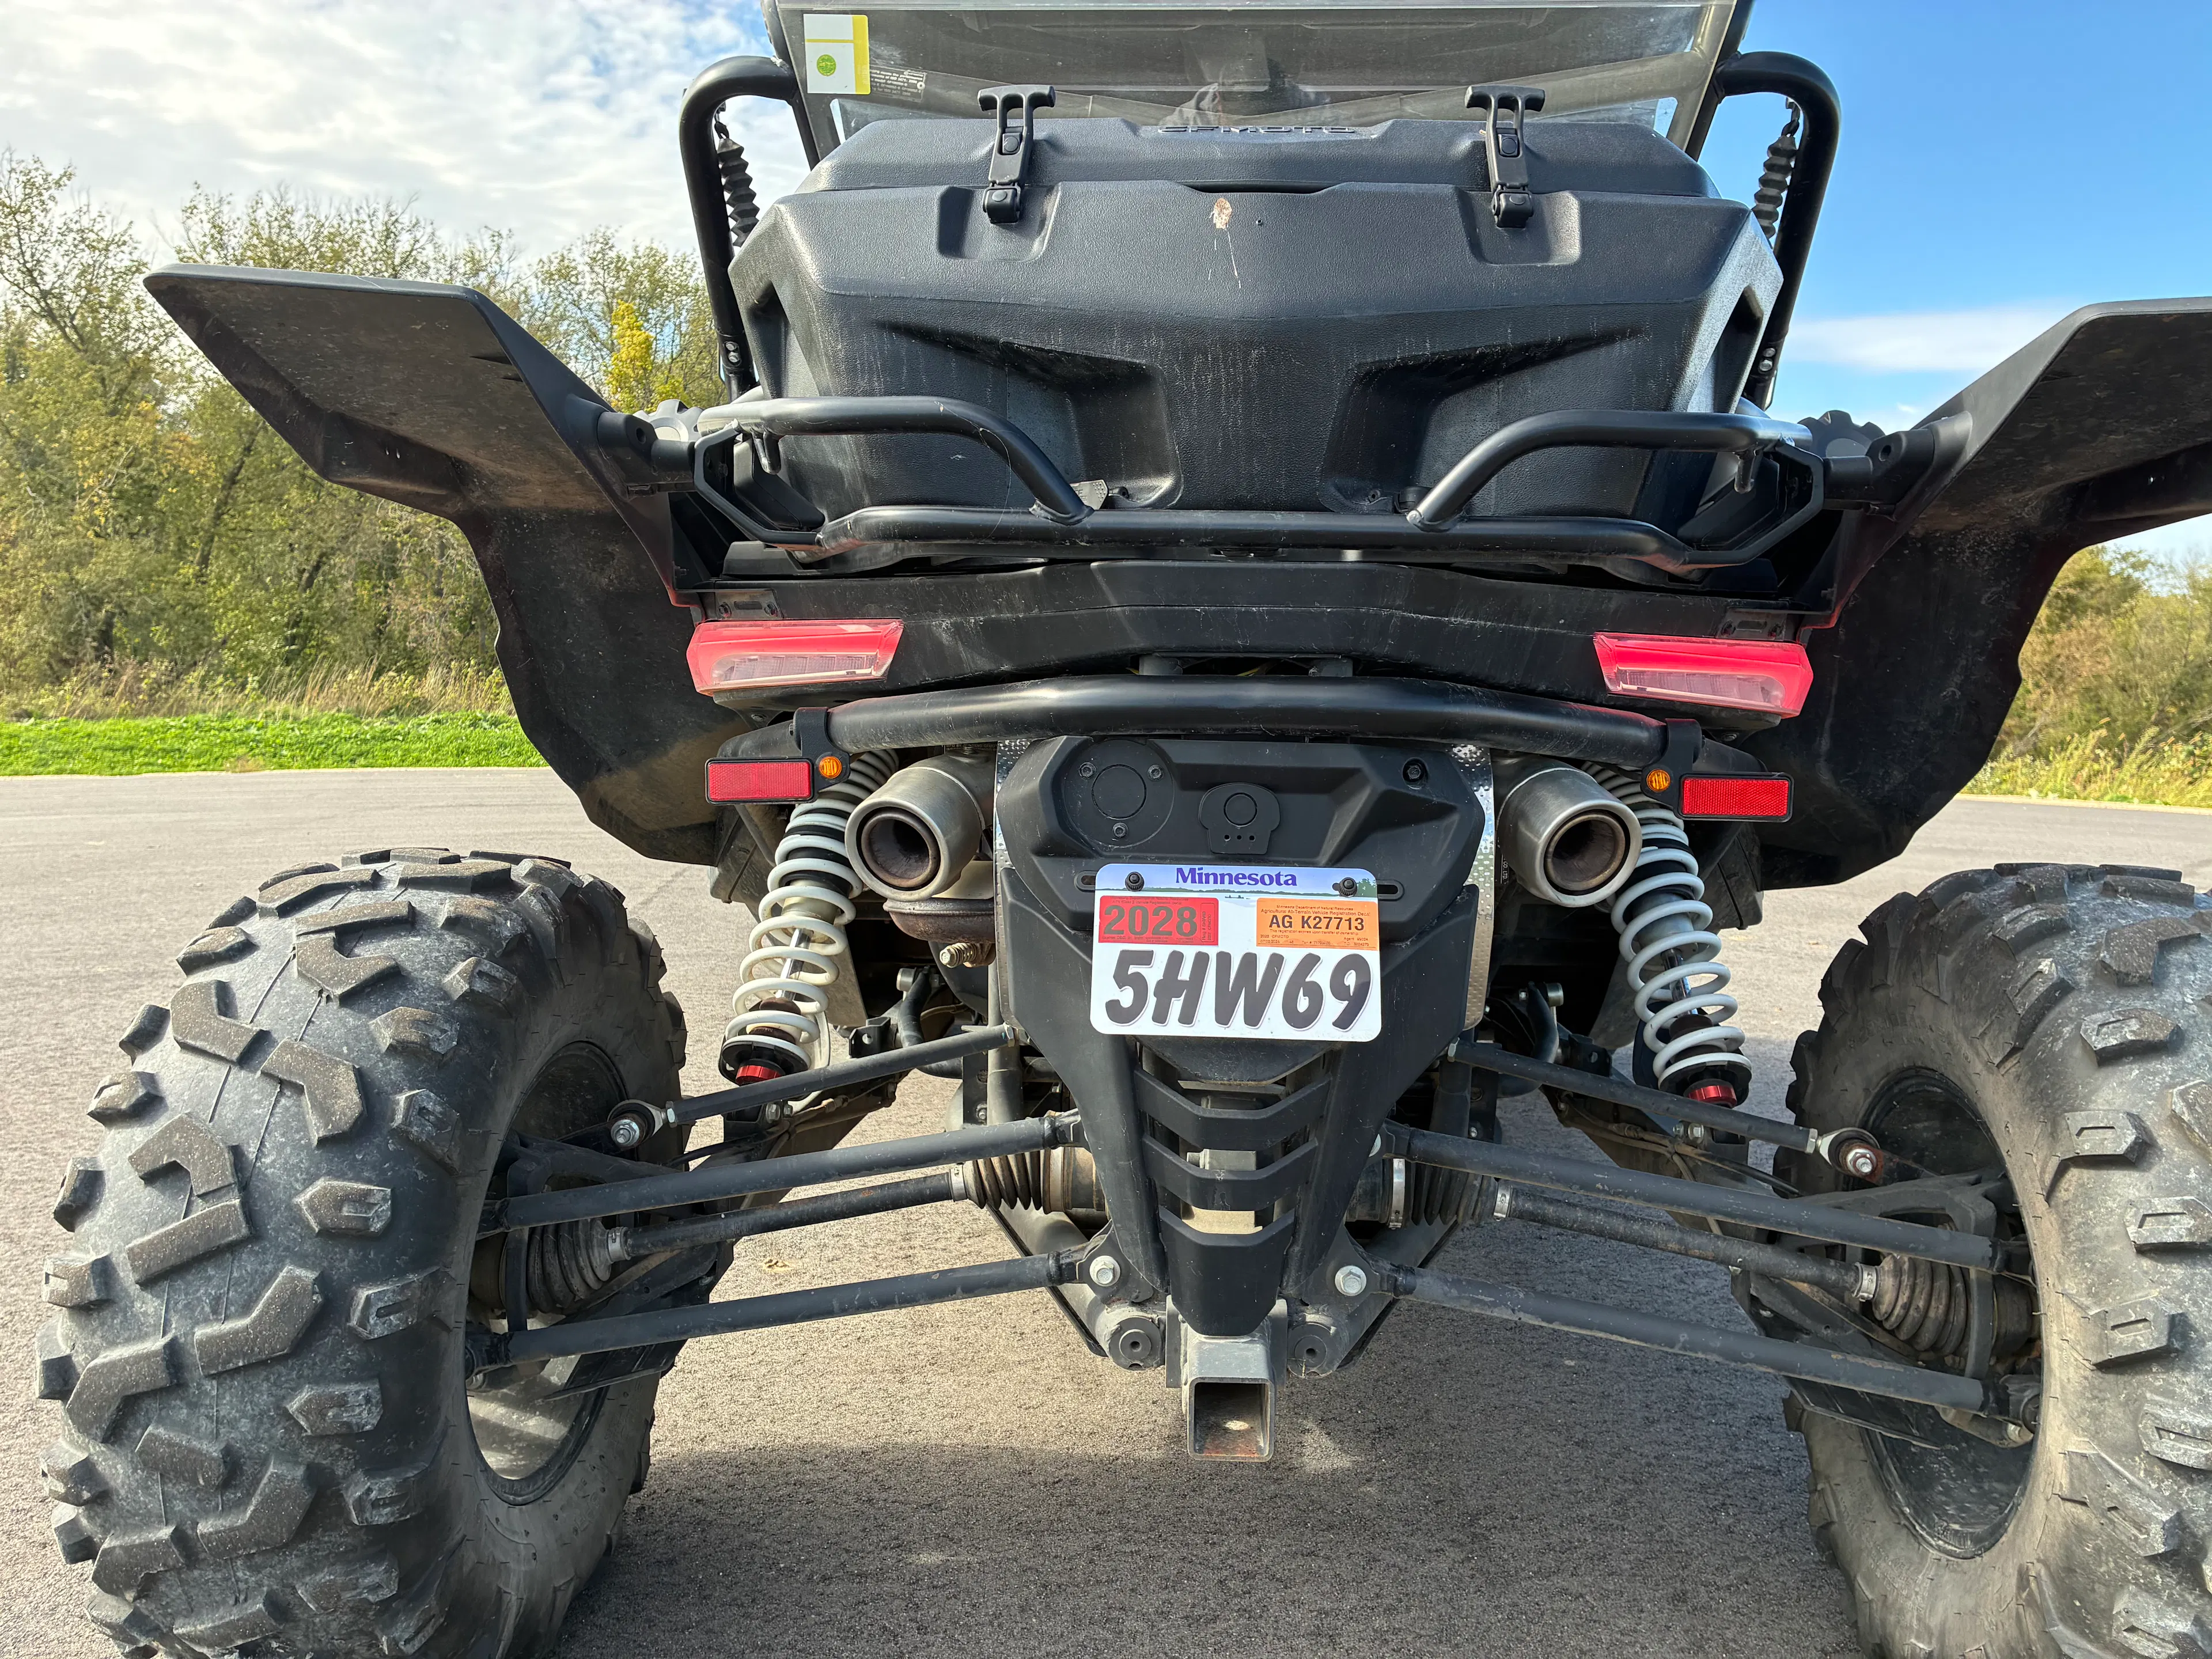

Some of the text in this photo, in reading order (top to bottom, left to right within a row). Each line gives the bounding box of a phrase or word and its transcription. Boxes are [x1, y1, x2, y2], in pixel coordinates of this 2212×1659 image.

[1176, 867, 1297, 887] Minnesota
[1104, 905, 1198, 937] 2028
[1269, 915, 1364, 931] AG K27713
[1105, 949, 1372, 1031] 5HW69
